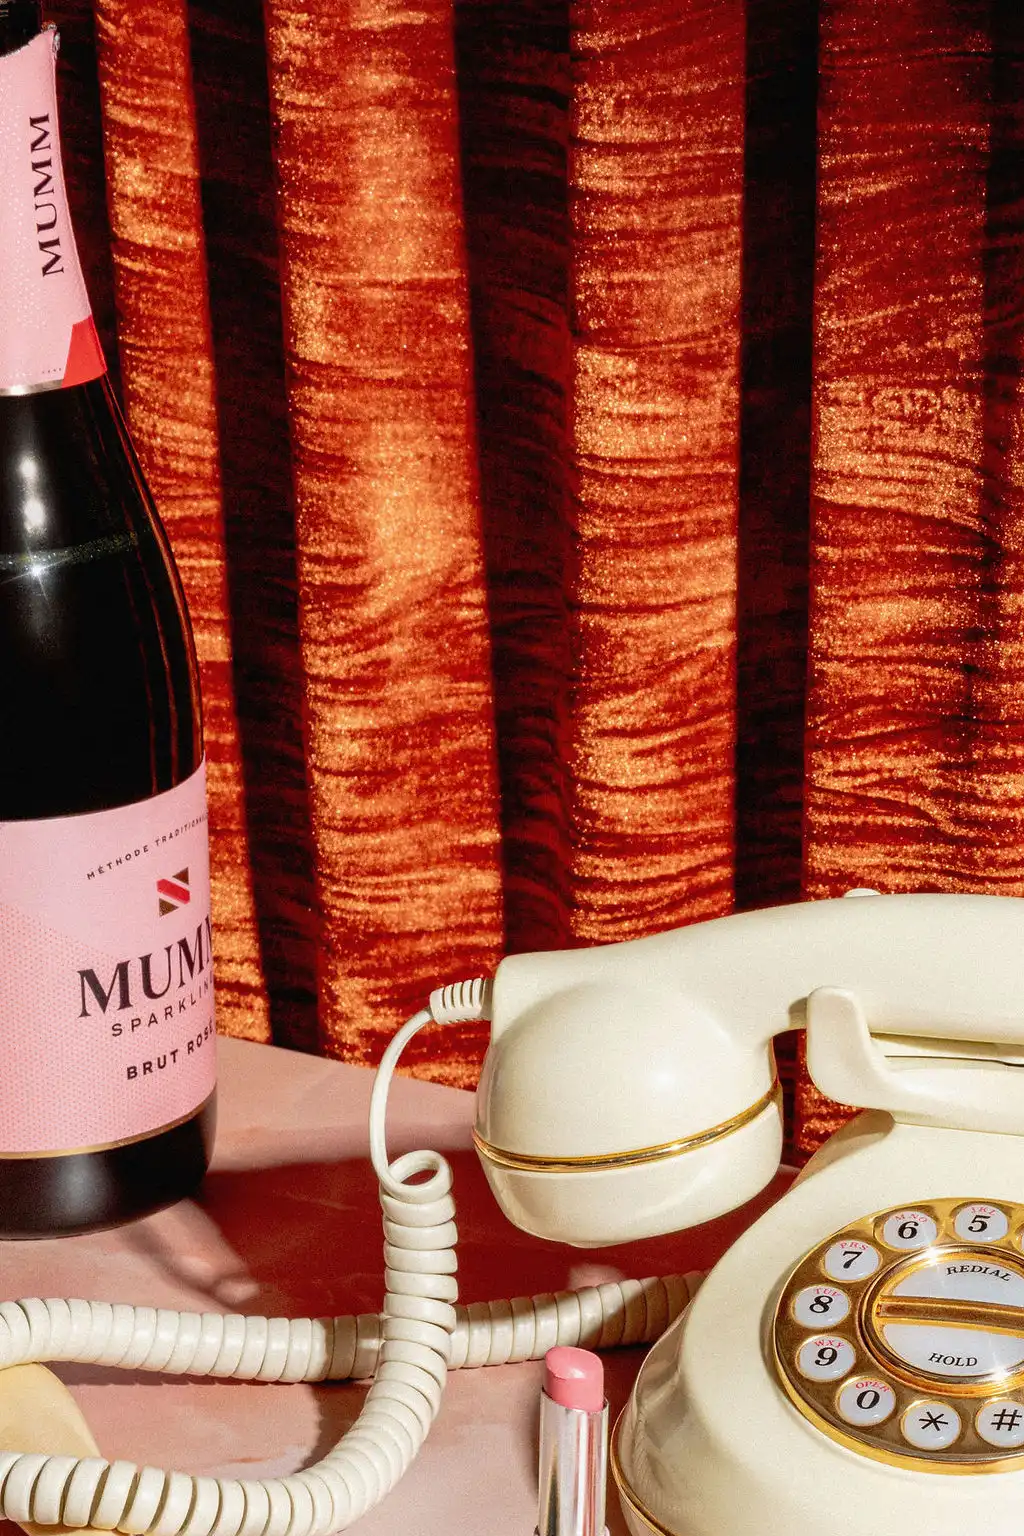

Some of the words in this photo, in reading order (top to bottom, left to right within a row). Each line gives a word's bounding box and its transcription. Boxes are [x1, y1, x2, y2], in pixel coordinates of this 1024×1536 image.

[29, 113, 65, 277] MUMM
[86, 845, 149, 880] MÉTHODE
[127, 1049, 178, 1080] BRUT
[897, 1221, 919, 1239] 6
[968, 1214, 991, 1232] 5
[840, 1241, 868, 1250] PRS
[842, 1250, 863, 1269] 7
[946, 1264, 1012, 1282] REDIAL
[809, 1295, 833, 1314] 8
[814, 1339, 845, 1349] WXY
[814, 1346, 838, 1367] 9
[928, 1352, 978, 1367] HOLD
[855, 1380, 890, 1392] OPER
[856, 1389, 881, 1410] 0
[991, 1408, 1023, 1432] #
